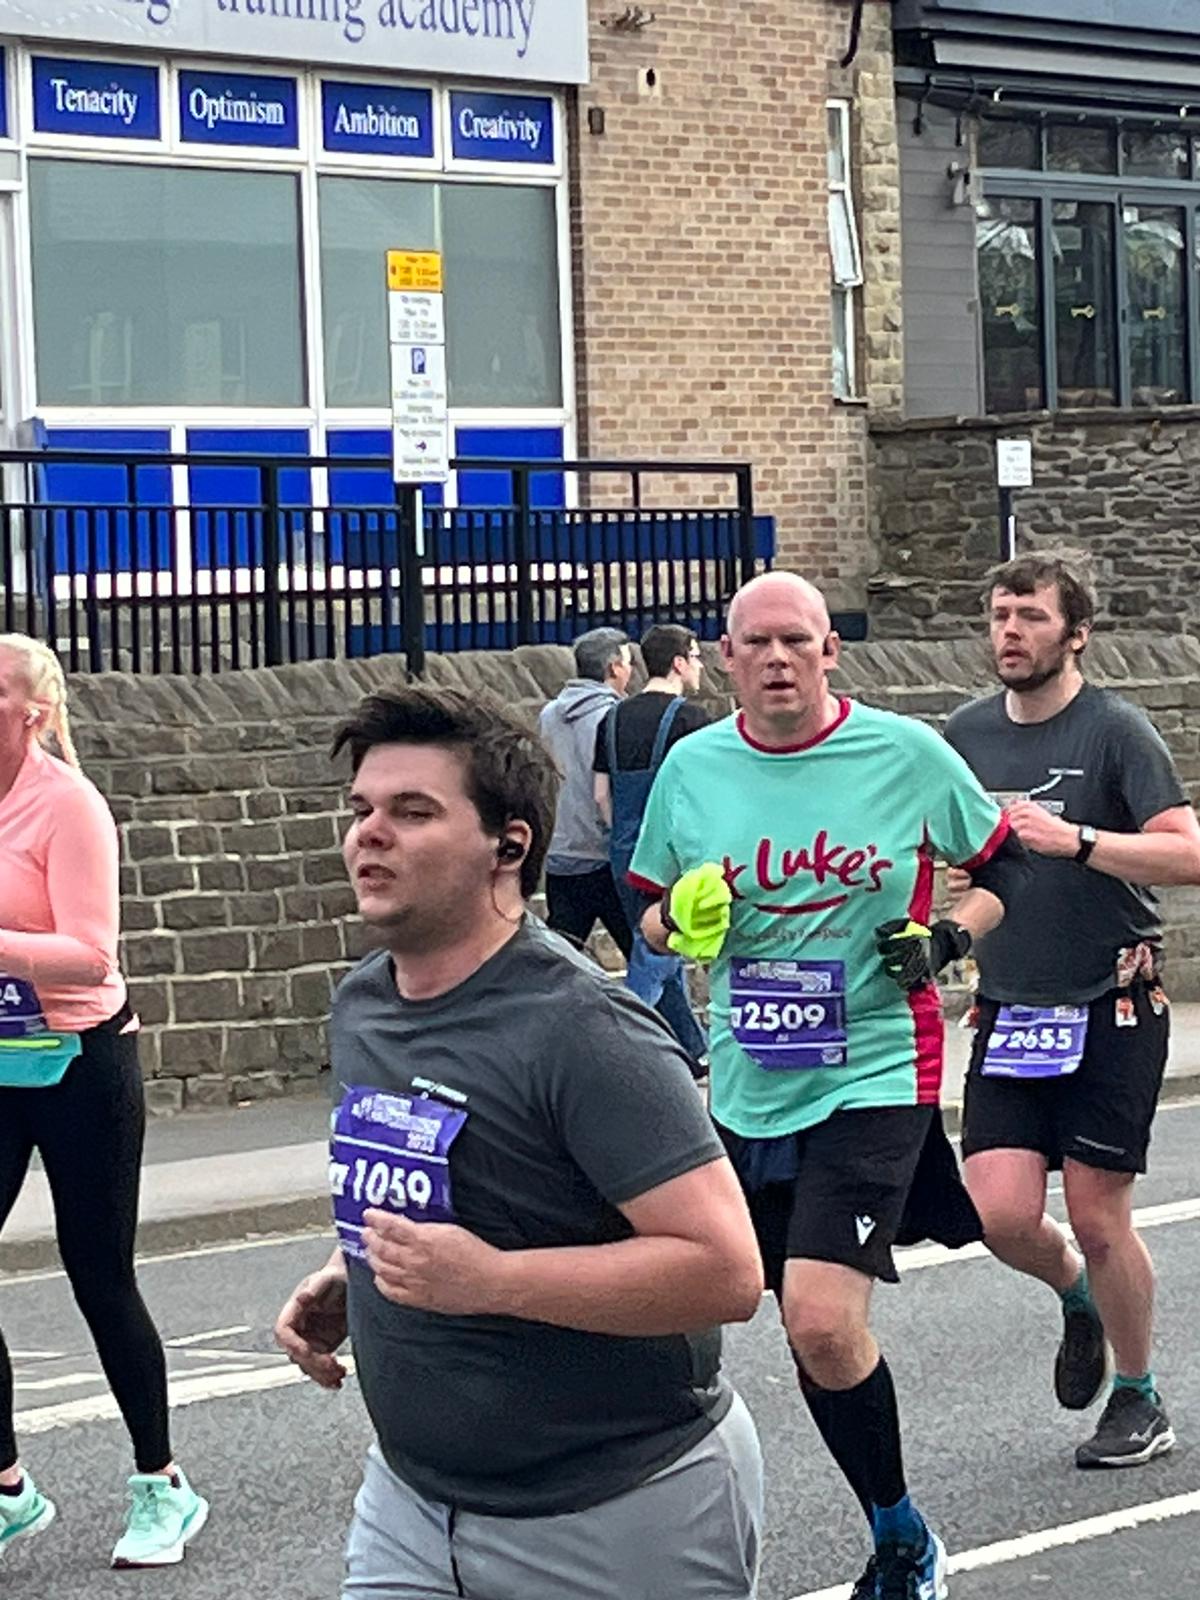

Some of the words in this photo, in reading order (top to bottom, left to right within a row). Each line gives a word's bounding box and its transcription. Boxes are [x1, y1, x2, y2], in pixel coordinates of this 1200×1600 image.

[51, 78, 138, 124] Tenacity
[189, 88, 285, 128] Optimism
[334, 103, 419, 138] Ambition
[459, 108, 542, 150] Creativity
[756, 830, 893, 892] Luke's
[0, 983, 22, 1006] 4
[744, 1001, 826, 1031] 2509
[1006, 1028, 1072, 1050] 2655
[353, 1157, 432, 1210] 1059
